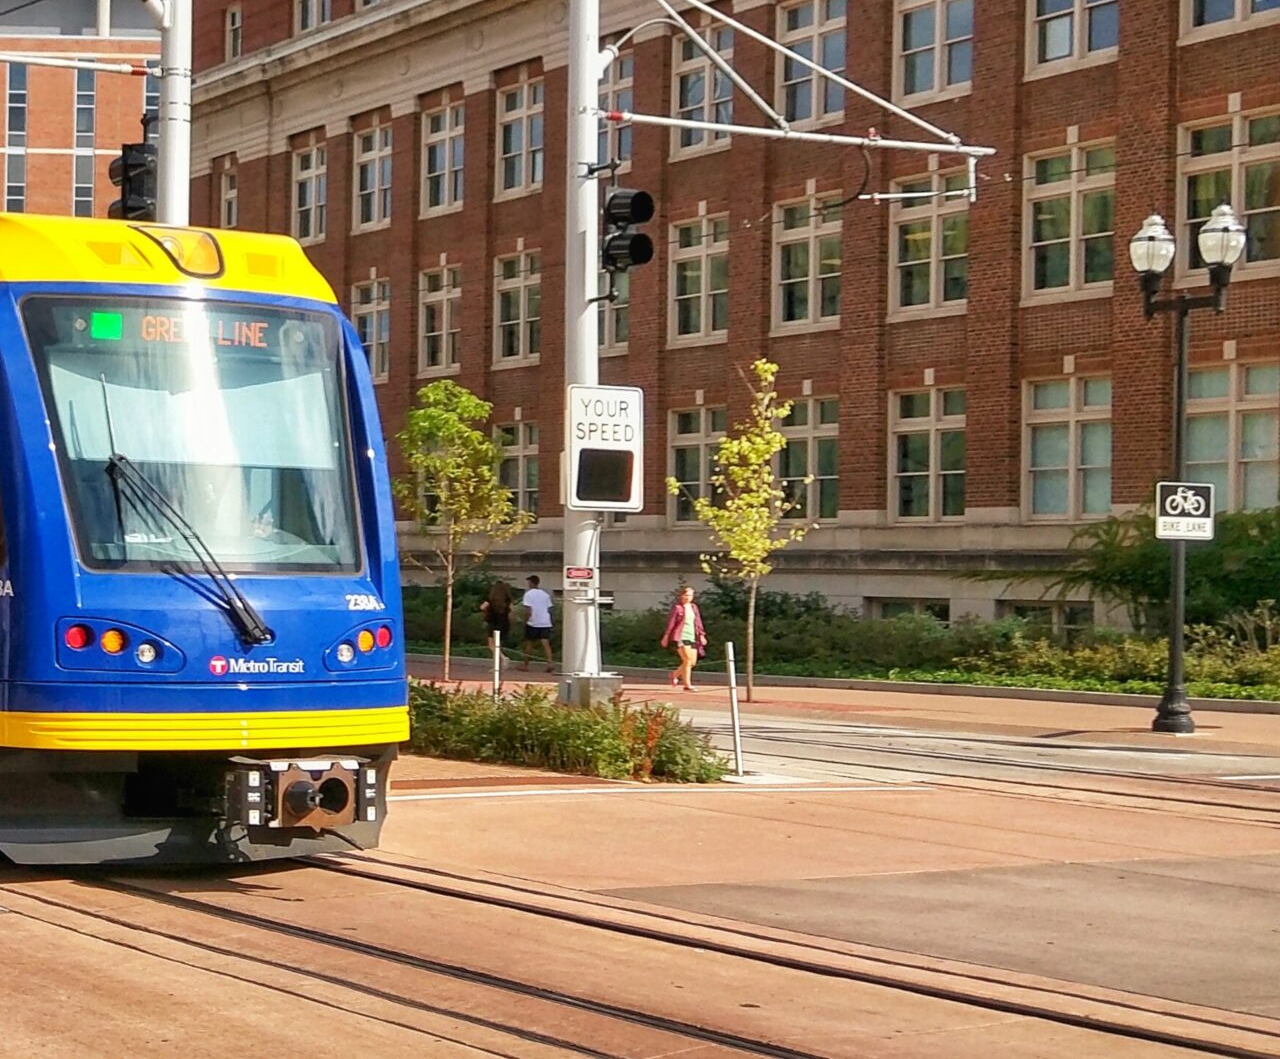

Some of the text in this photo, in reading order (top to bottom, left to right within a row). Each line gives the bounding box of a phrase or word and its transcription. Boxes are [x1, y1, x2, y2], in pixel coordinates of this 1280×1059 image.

[141, 314, 269, 348] GRE LINE
[580, 398, 629, 419] YOUR
[576, 422, 634, 442] SPEED
[1162, 521, 1207, 533] BIKE LANE
